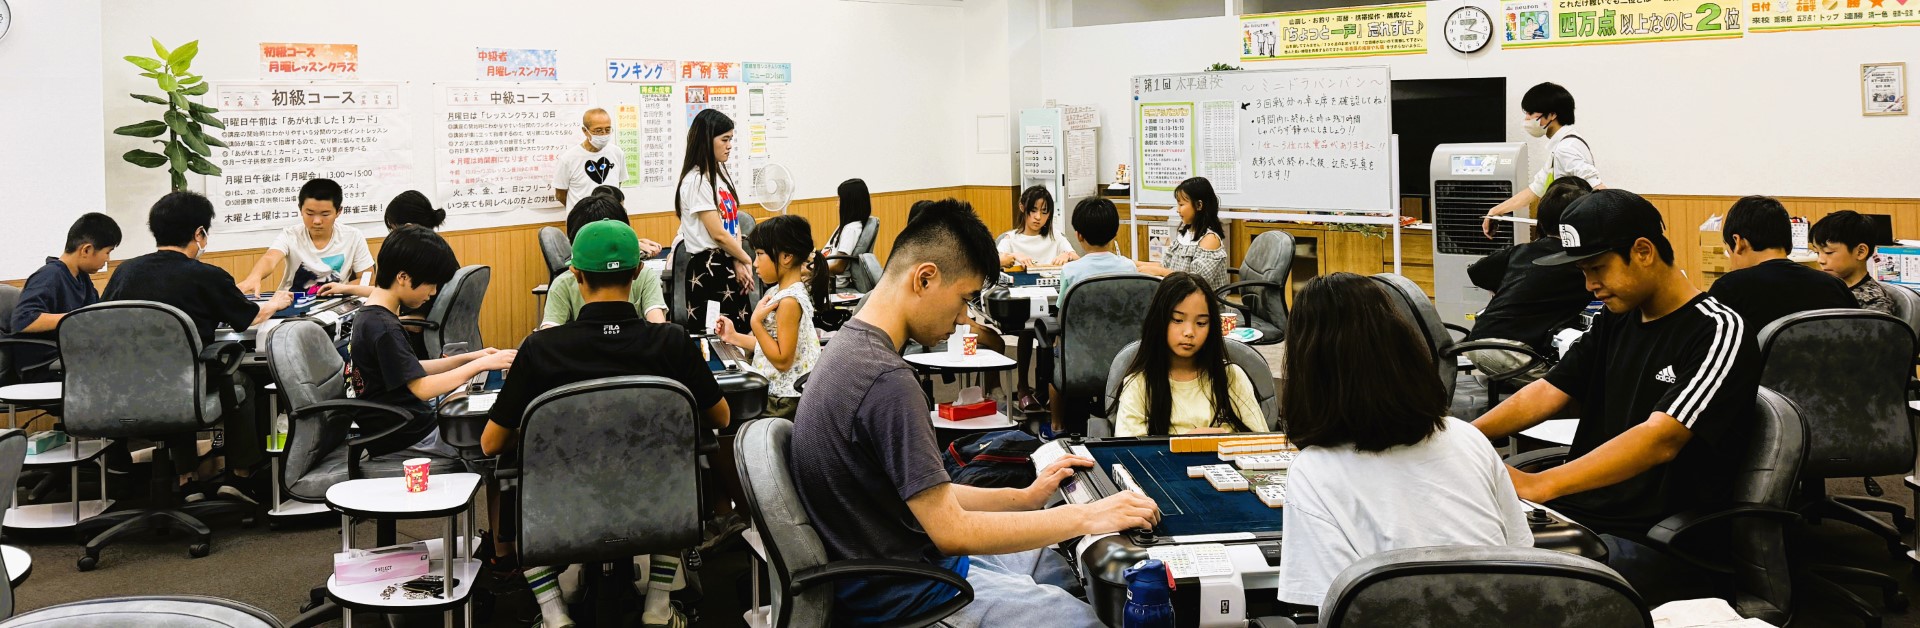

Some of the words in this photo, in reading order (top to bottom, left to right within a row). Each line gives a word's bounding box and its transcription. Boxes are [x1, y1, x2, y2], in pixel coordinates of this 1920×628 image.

[1751, 3, 1770, 12] 日付
[264, 47, 315, 58] 初級コース
[478, 51, 507, 62] 中級者
[269, 61, 356, 73] 月曜レッスンクラス
[486, 66, 556, 77] 月曜レッスンクラス
[609, 61, 663, 80] ランキング
[682, 63, 729, 79] 月例祭
[1144, 78, 1171, 93] 第1回
[271, 89, 356, 106] 初級コース
[490, 90, 553, 104] 中級コース
